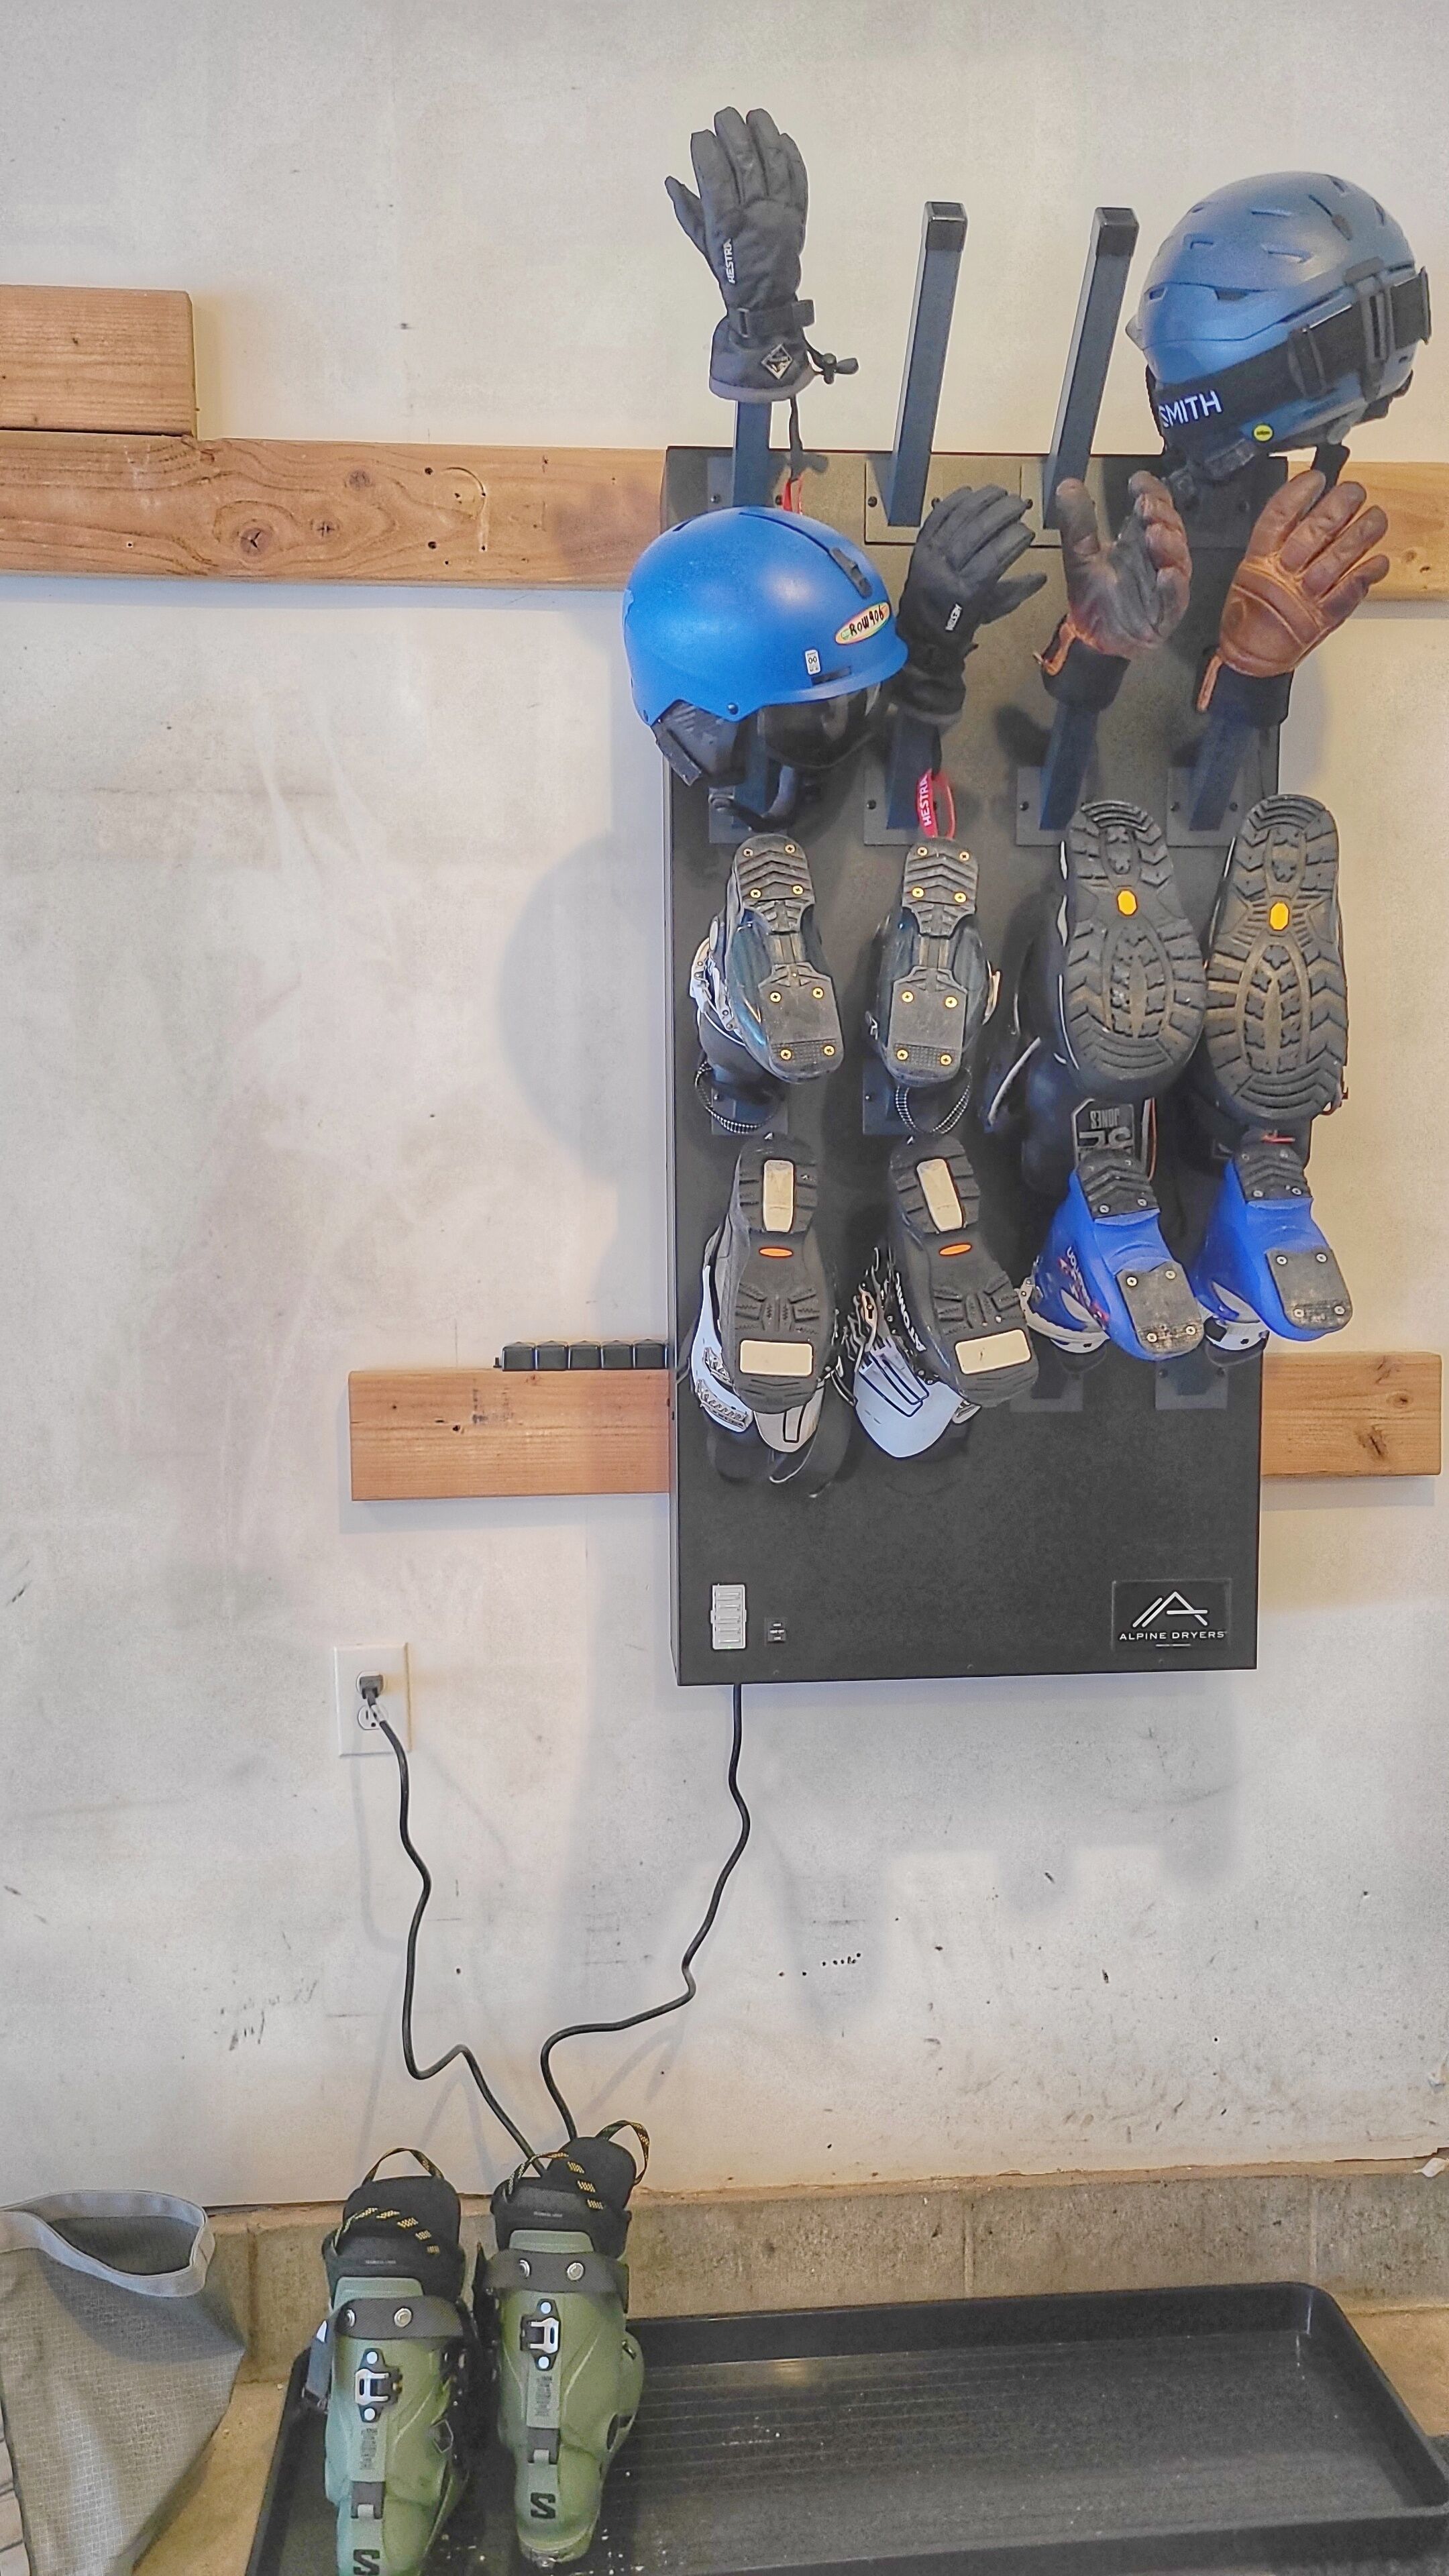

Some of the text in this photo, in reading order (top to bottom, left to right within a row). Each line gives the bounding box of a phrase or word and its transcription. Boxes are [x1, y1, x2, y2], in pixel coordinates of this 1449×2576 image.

[723, 238, 736, 284] HESTRA
[1159, 390, 1222, 427] SMITH
[920, 774, 932, 826] HESTRA
[1090, 1108, 1120, 1129] JONES
[896, 1273, 926, 1351] ATOMIC
[1119, 1631, 1226, 1641] ALPINE DRYERS
[531, 2492, 556, 2519] S
[353, 2549, 380, 2576] S
